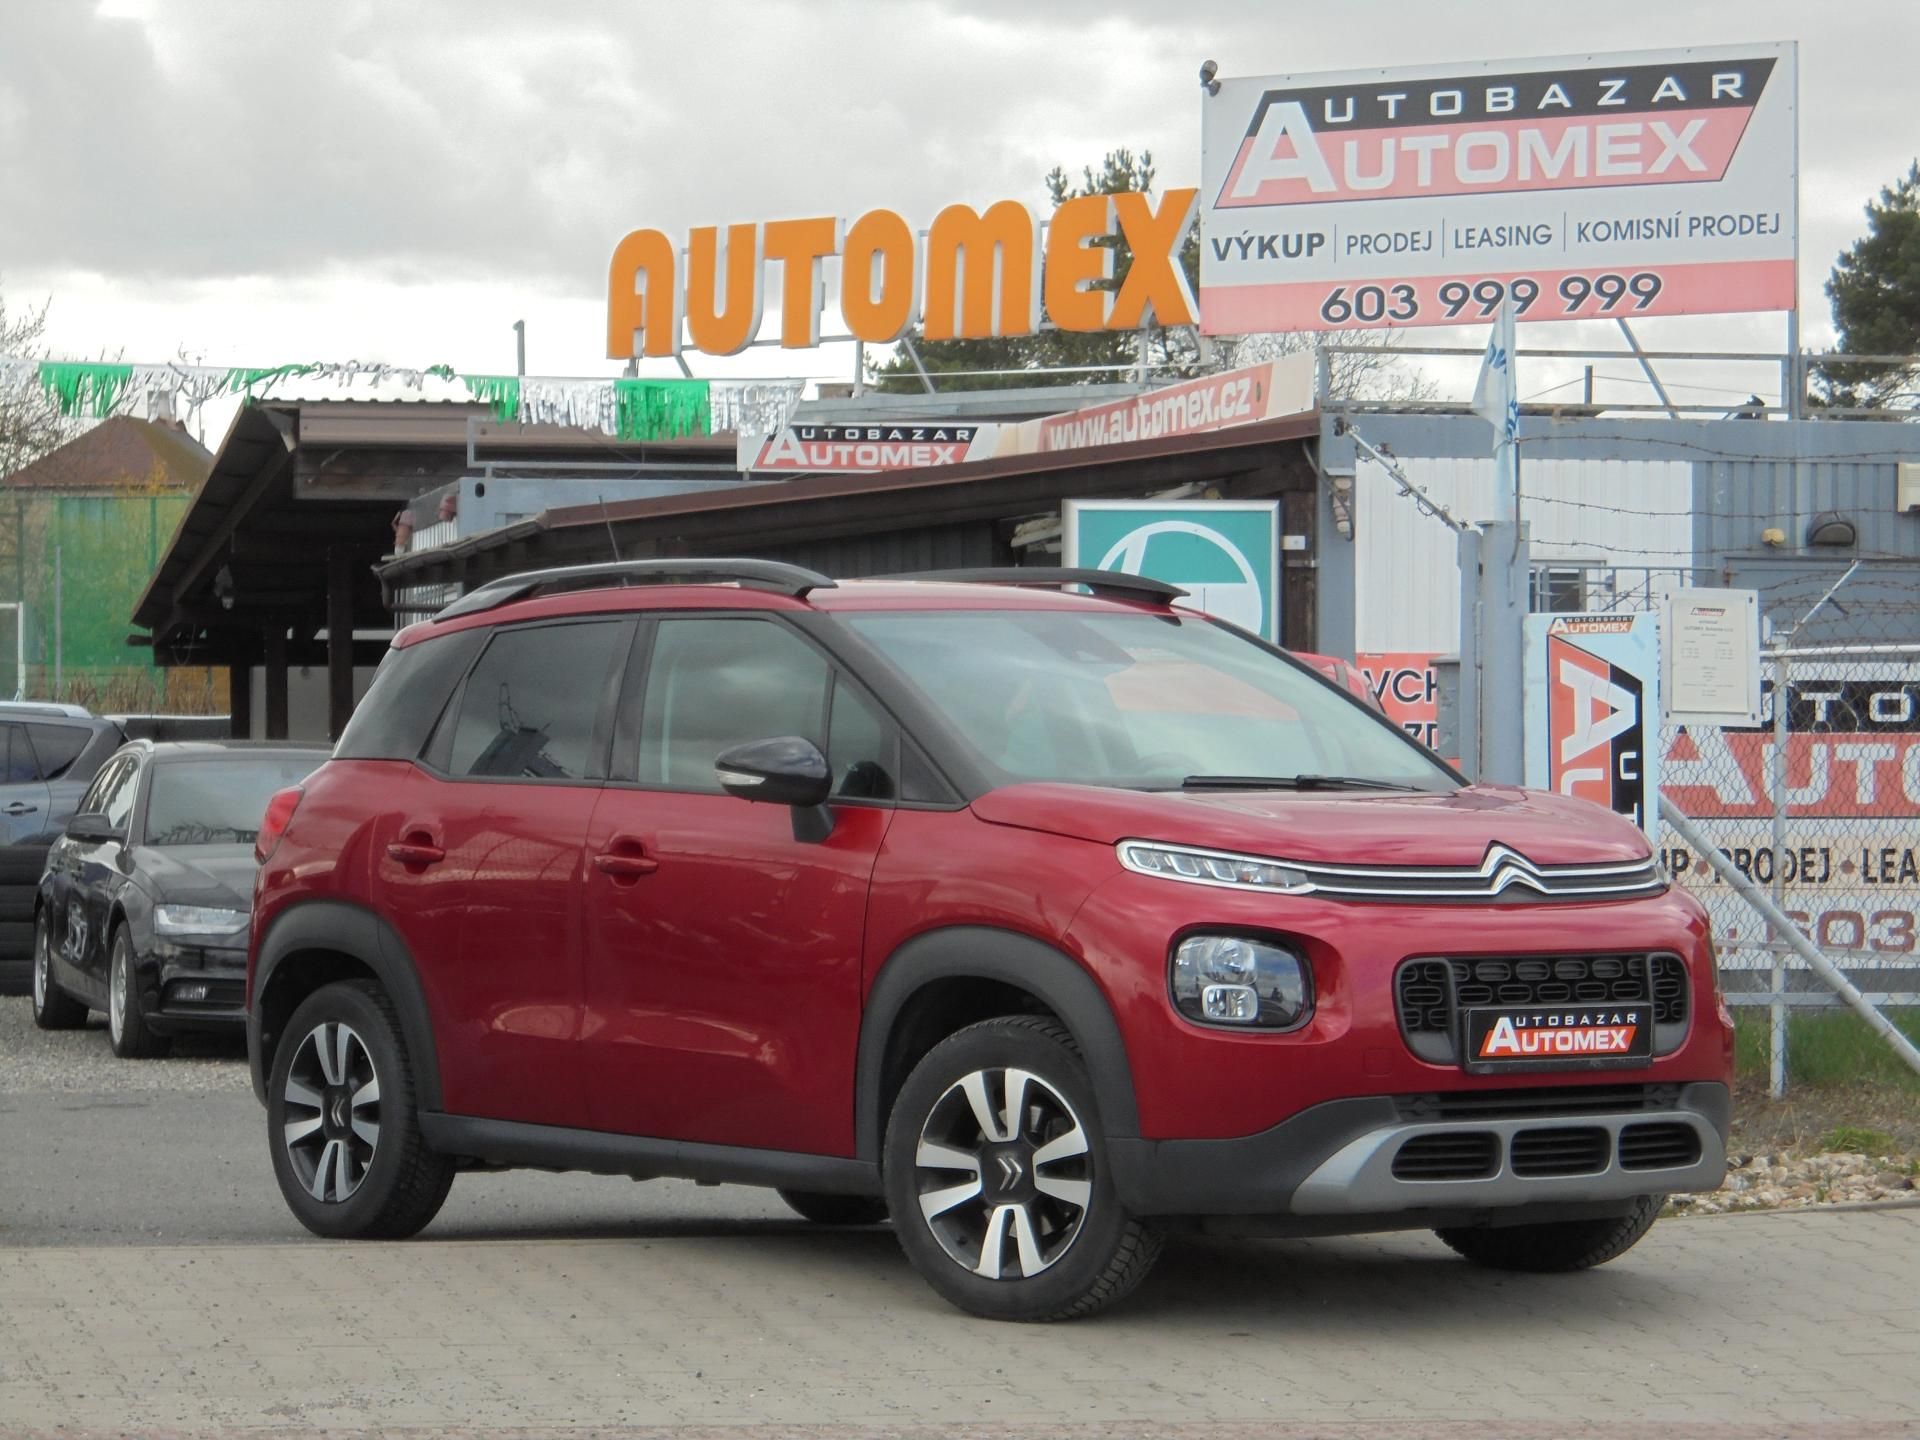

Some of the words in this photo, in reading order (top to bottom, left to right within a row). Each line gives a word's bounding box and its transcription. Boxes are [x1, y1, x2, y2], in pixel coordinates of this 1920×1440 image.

[1231, 101, 1708, 198] AUTOMEX
[1211, 231, 1326, 262] VÝKUP
[1346, 230, 1433, 255] PRODEJ
[1454, 224, 1553, 250] LEASING
[1577, 211, 1682, 243] KOMISNÍ
[1688, 213, 1780, 238] PRODEJ
[606, 188, 1200, 358] AUTOMEX
[1321, 285, 1419, 323] 603
[1438, 278, 1540, 317] 999
[1559, 272, 1663, 311] 999
[1051, 377, 1251, 451] www.automex.cz
[763, 428, 957, 466] AUTOMEX
[1550, 617, 1628, 634] AUTOMEX
[1486, 1017, 1627, 1053] AUTOMEX
